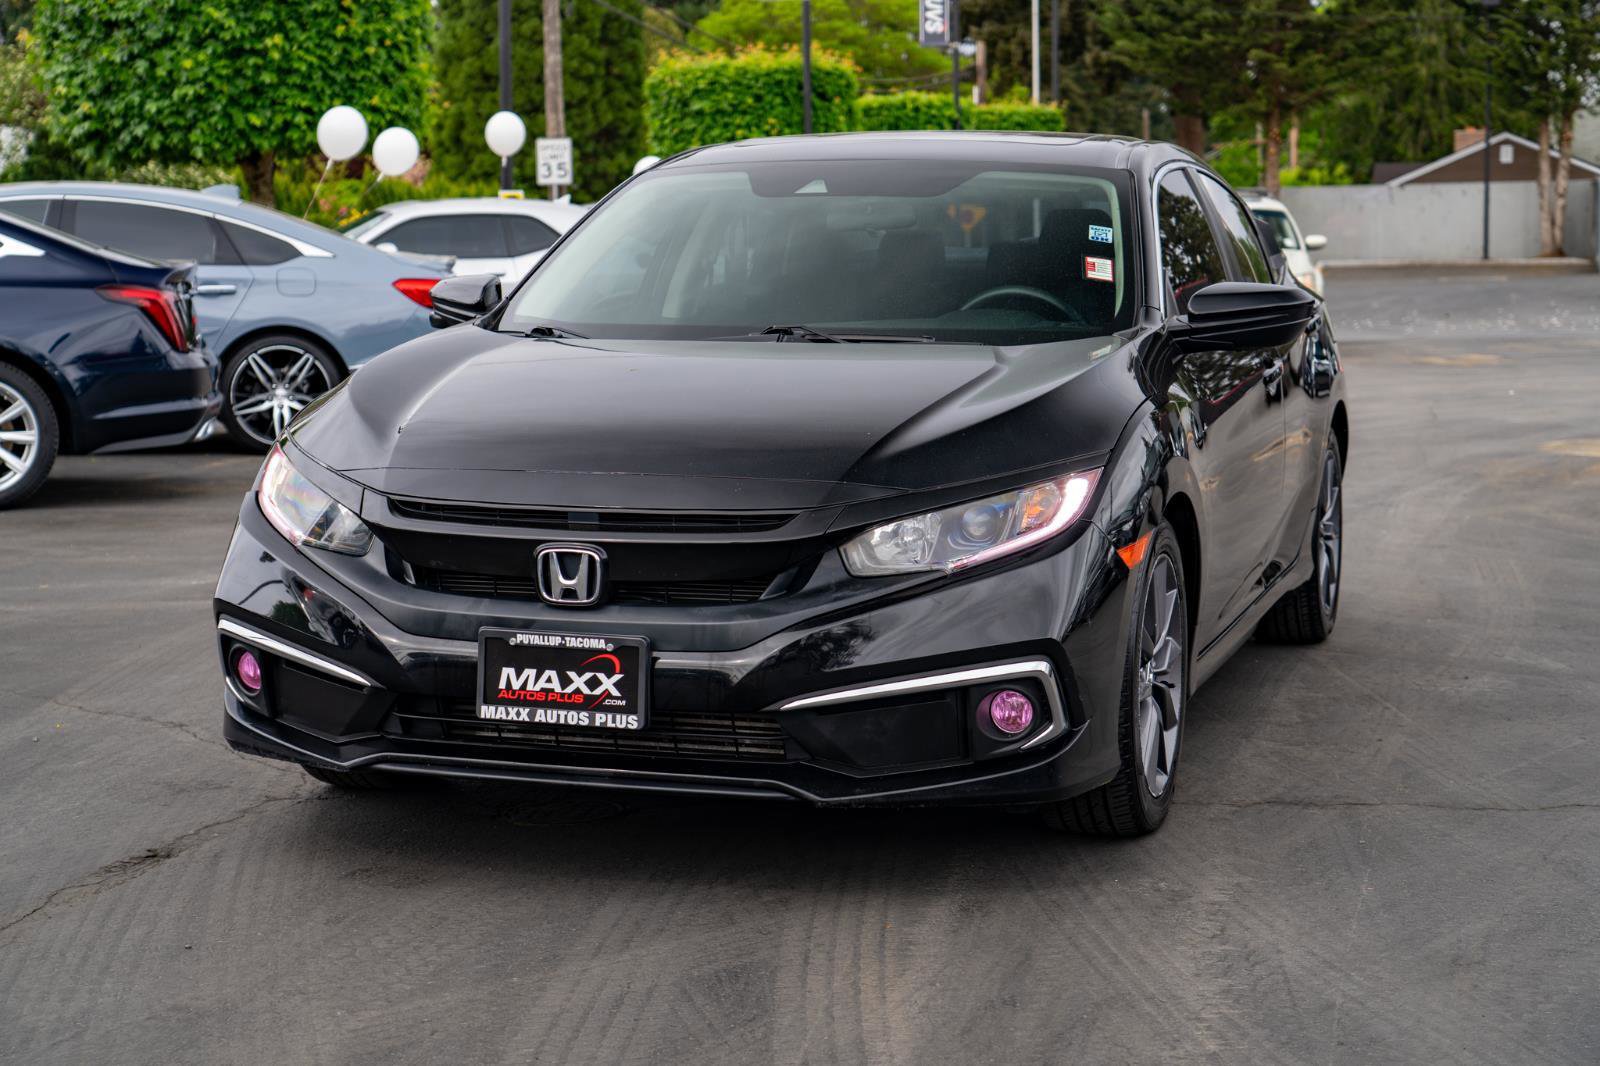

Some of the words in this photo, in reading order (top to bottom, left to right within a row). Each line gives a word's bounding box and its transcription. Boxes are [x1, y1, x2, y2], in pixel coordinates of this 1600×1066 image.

[542, 162, 568, 178] 35
[498, 667, 625, 697] MAXX
[497, 690, 545, 701] AUTOS
[547, 692, 584, 703] PLUS
[480, 705, 530, 722] MAXX
[534, 709, 589, 726] AUTOS
[595, 713, 639, 730] PLUS
